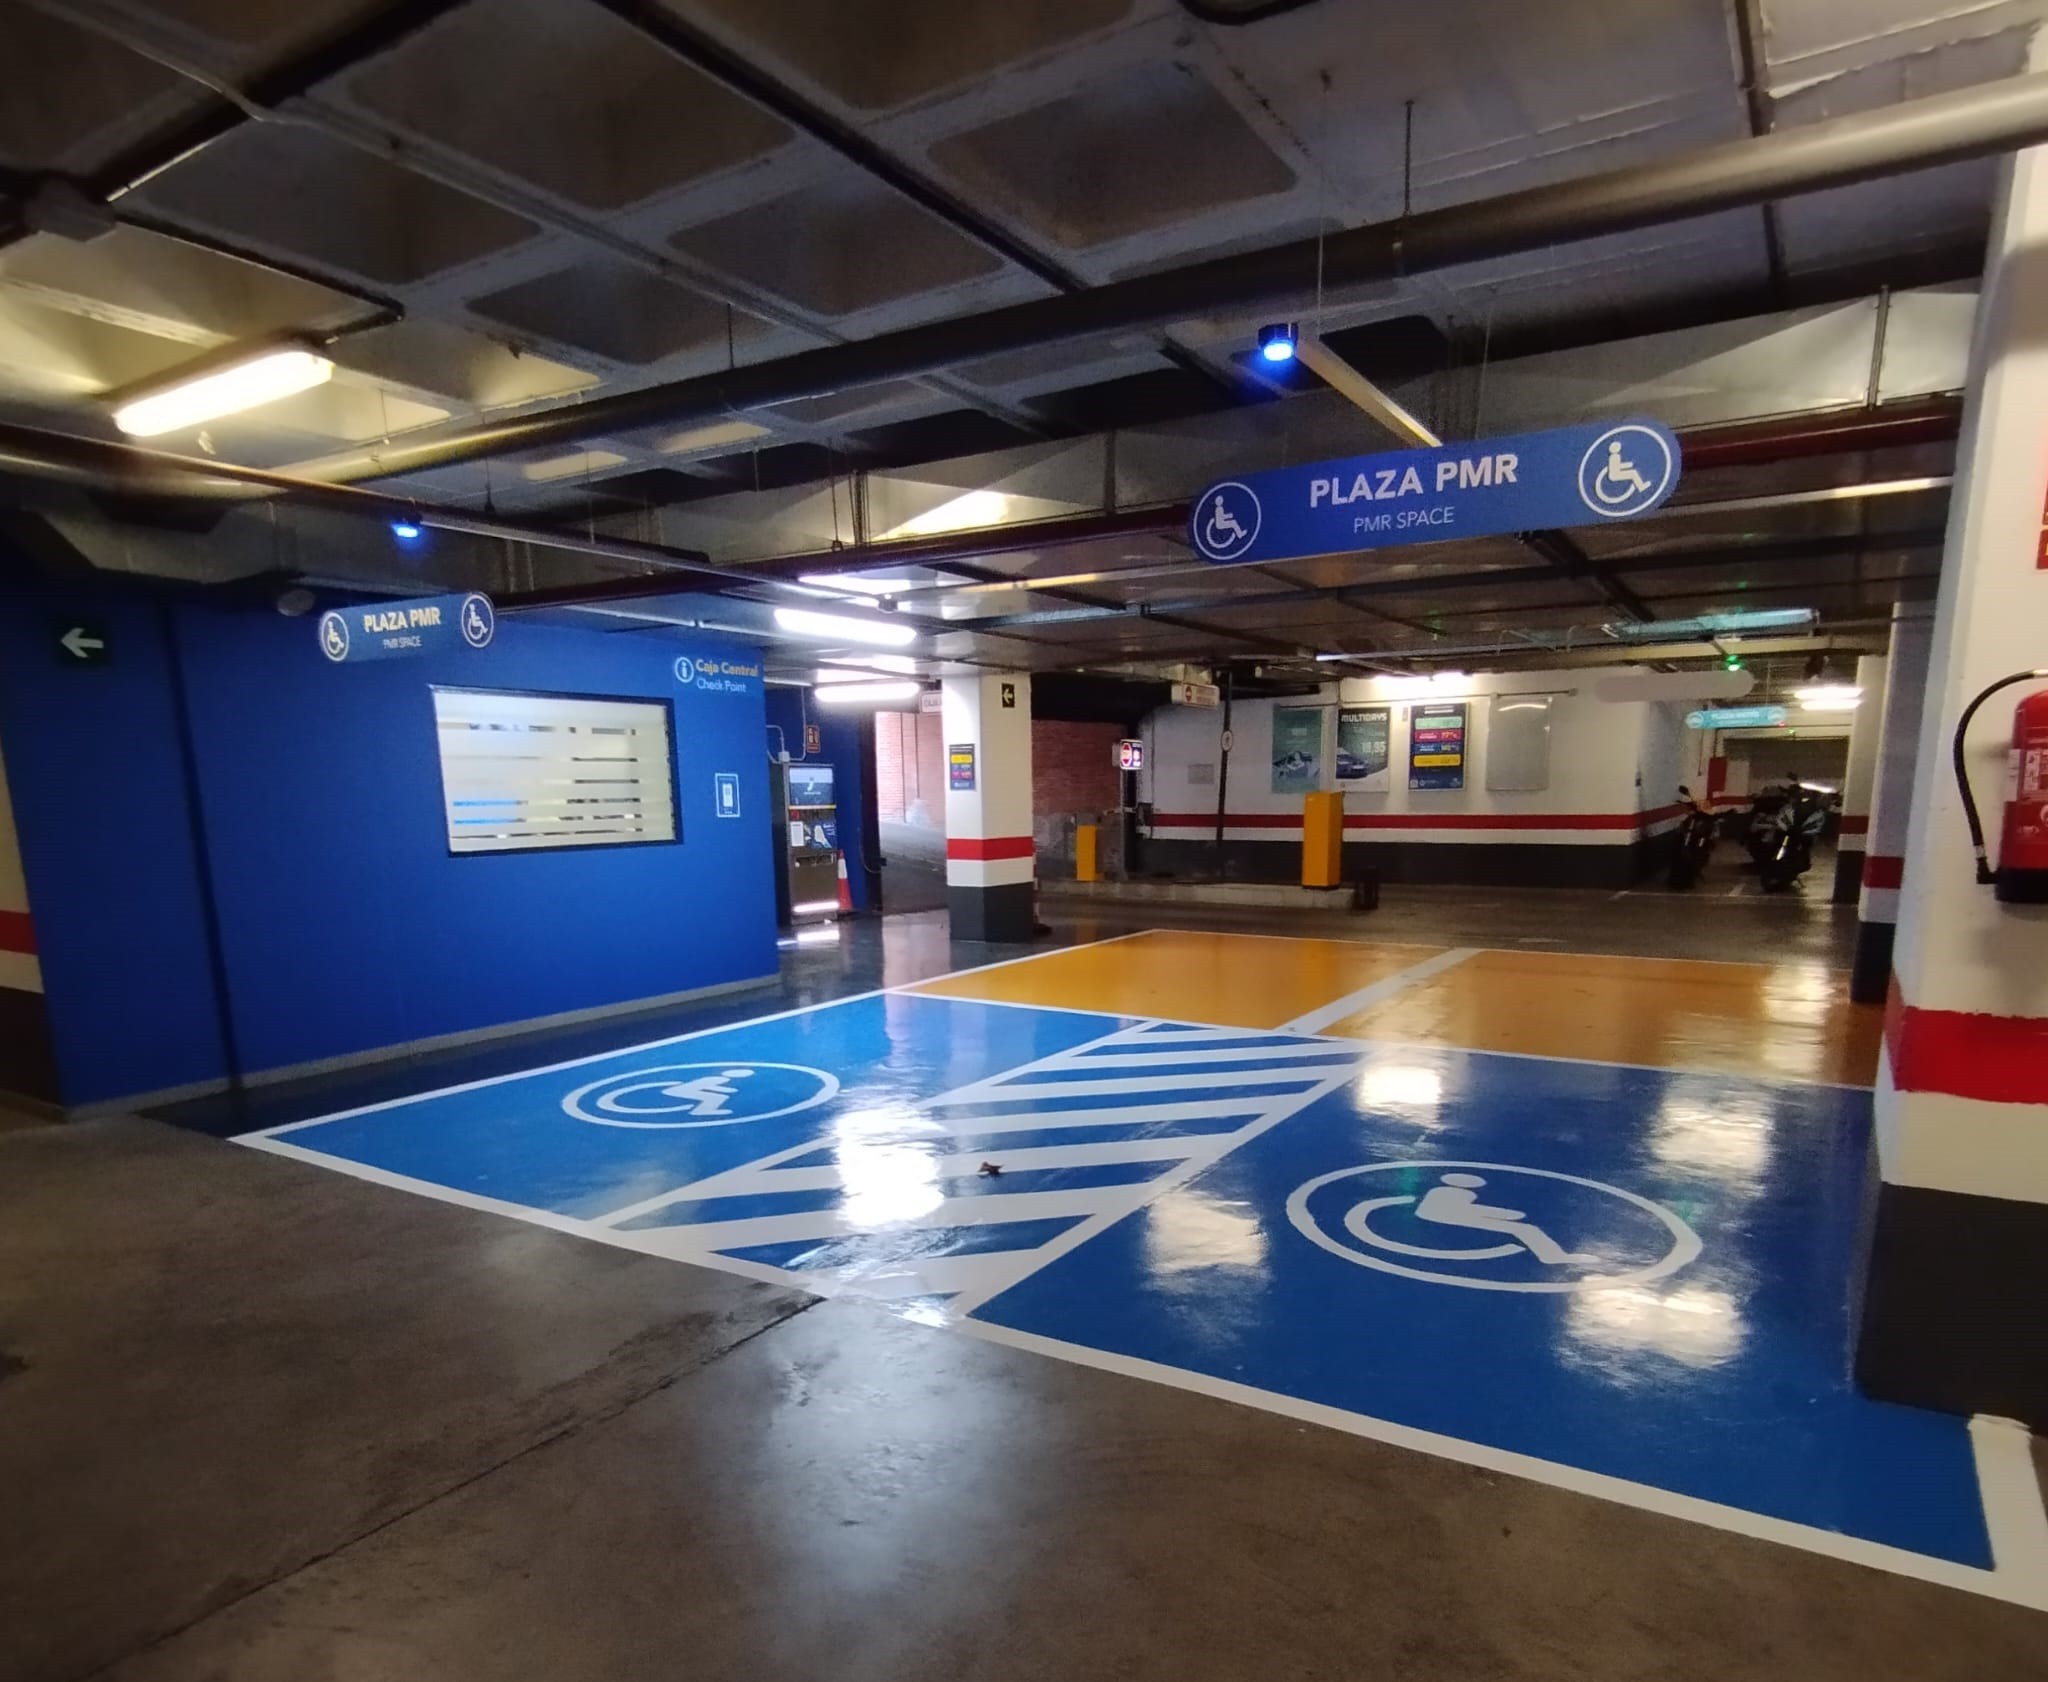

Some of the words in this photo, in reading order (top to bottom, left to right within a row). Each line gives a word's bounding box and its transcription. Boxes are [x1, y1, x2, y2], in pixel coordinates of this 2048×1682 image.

[1310, 468, 1423, 507] PLAZA
[1436, 453, 1519, 492] PMR
[1352, 515, 1393, 534] PMR
[1395, 506, 1456, 528] SPACE
[364, 611, 408, 632] PLAZA
[410, 607, 441, 628] PMR
[400, 636, 422, 648] SPACE
[696, 660, 719, 675] Caja
[721, 661, 758, 677] Central
[696, 677, 723, 690] Check
[725, 680, 747, 693] Point
[1341, 712, 1388, 723] MULTIDAYS
